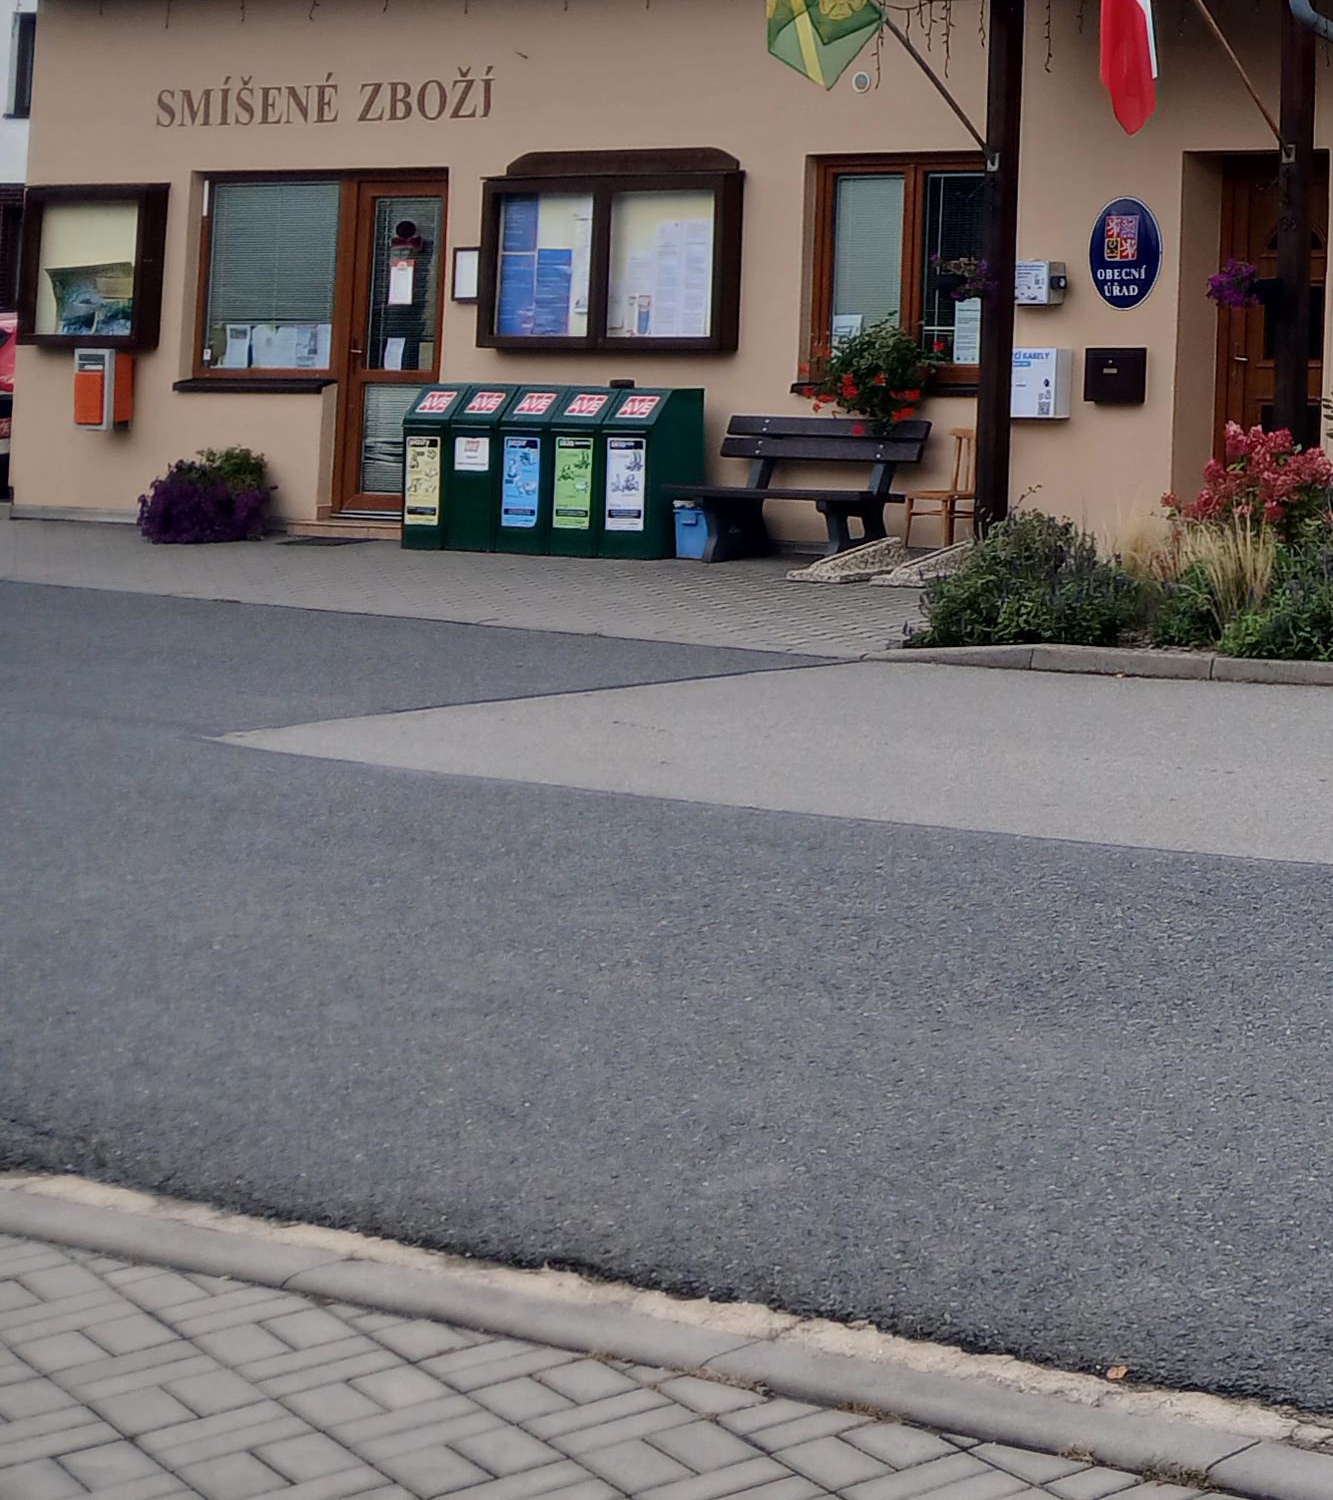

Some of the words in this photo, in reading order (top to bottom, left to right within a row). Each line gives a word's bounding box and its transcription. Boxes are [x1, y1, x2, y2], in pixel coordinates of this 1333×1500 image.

[155, 72, 339, 127] SMÍŠENÉ
[357, 65, 496, 122] ZBOŽÍ
[1096, 264, 1147, 280] OBECNÍ
[1104, 281, 1139, 296] ÚŘAD
[417, 393, 456, 411] AVE
[466, 393, 504, 412] AVE
[515, 394, 556, 413] AVE
[565, 395, 607, 415] AVE
[617, 397, 659, 417] AVE
